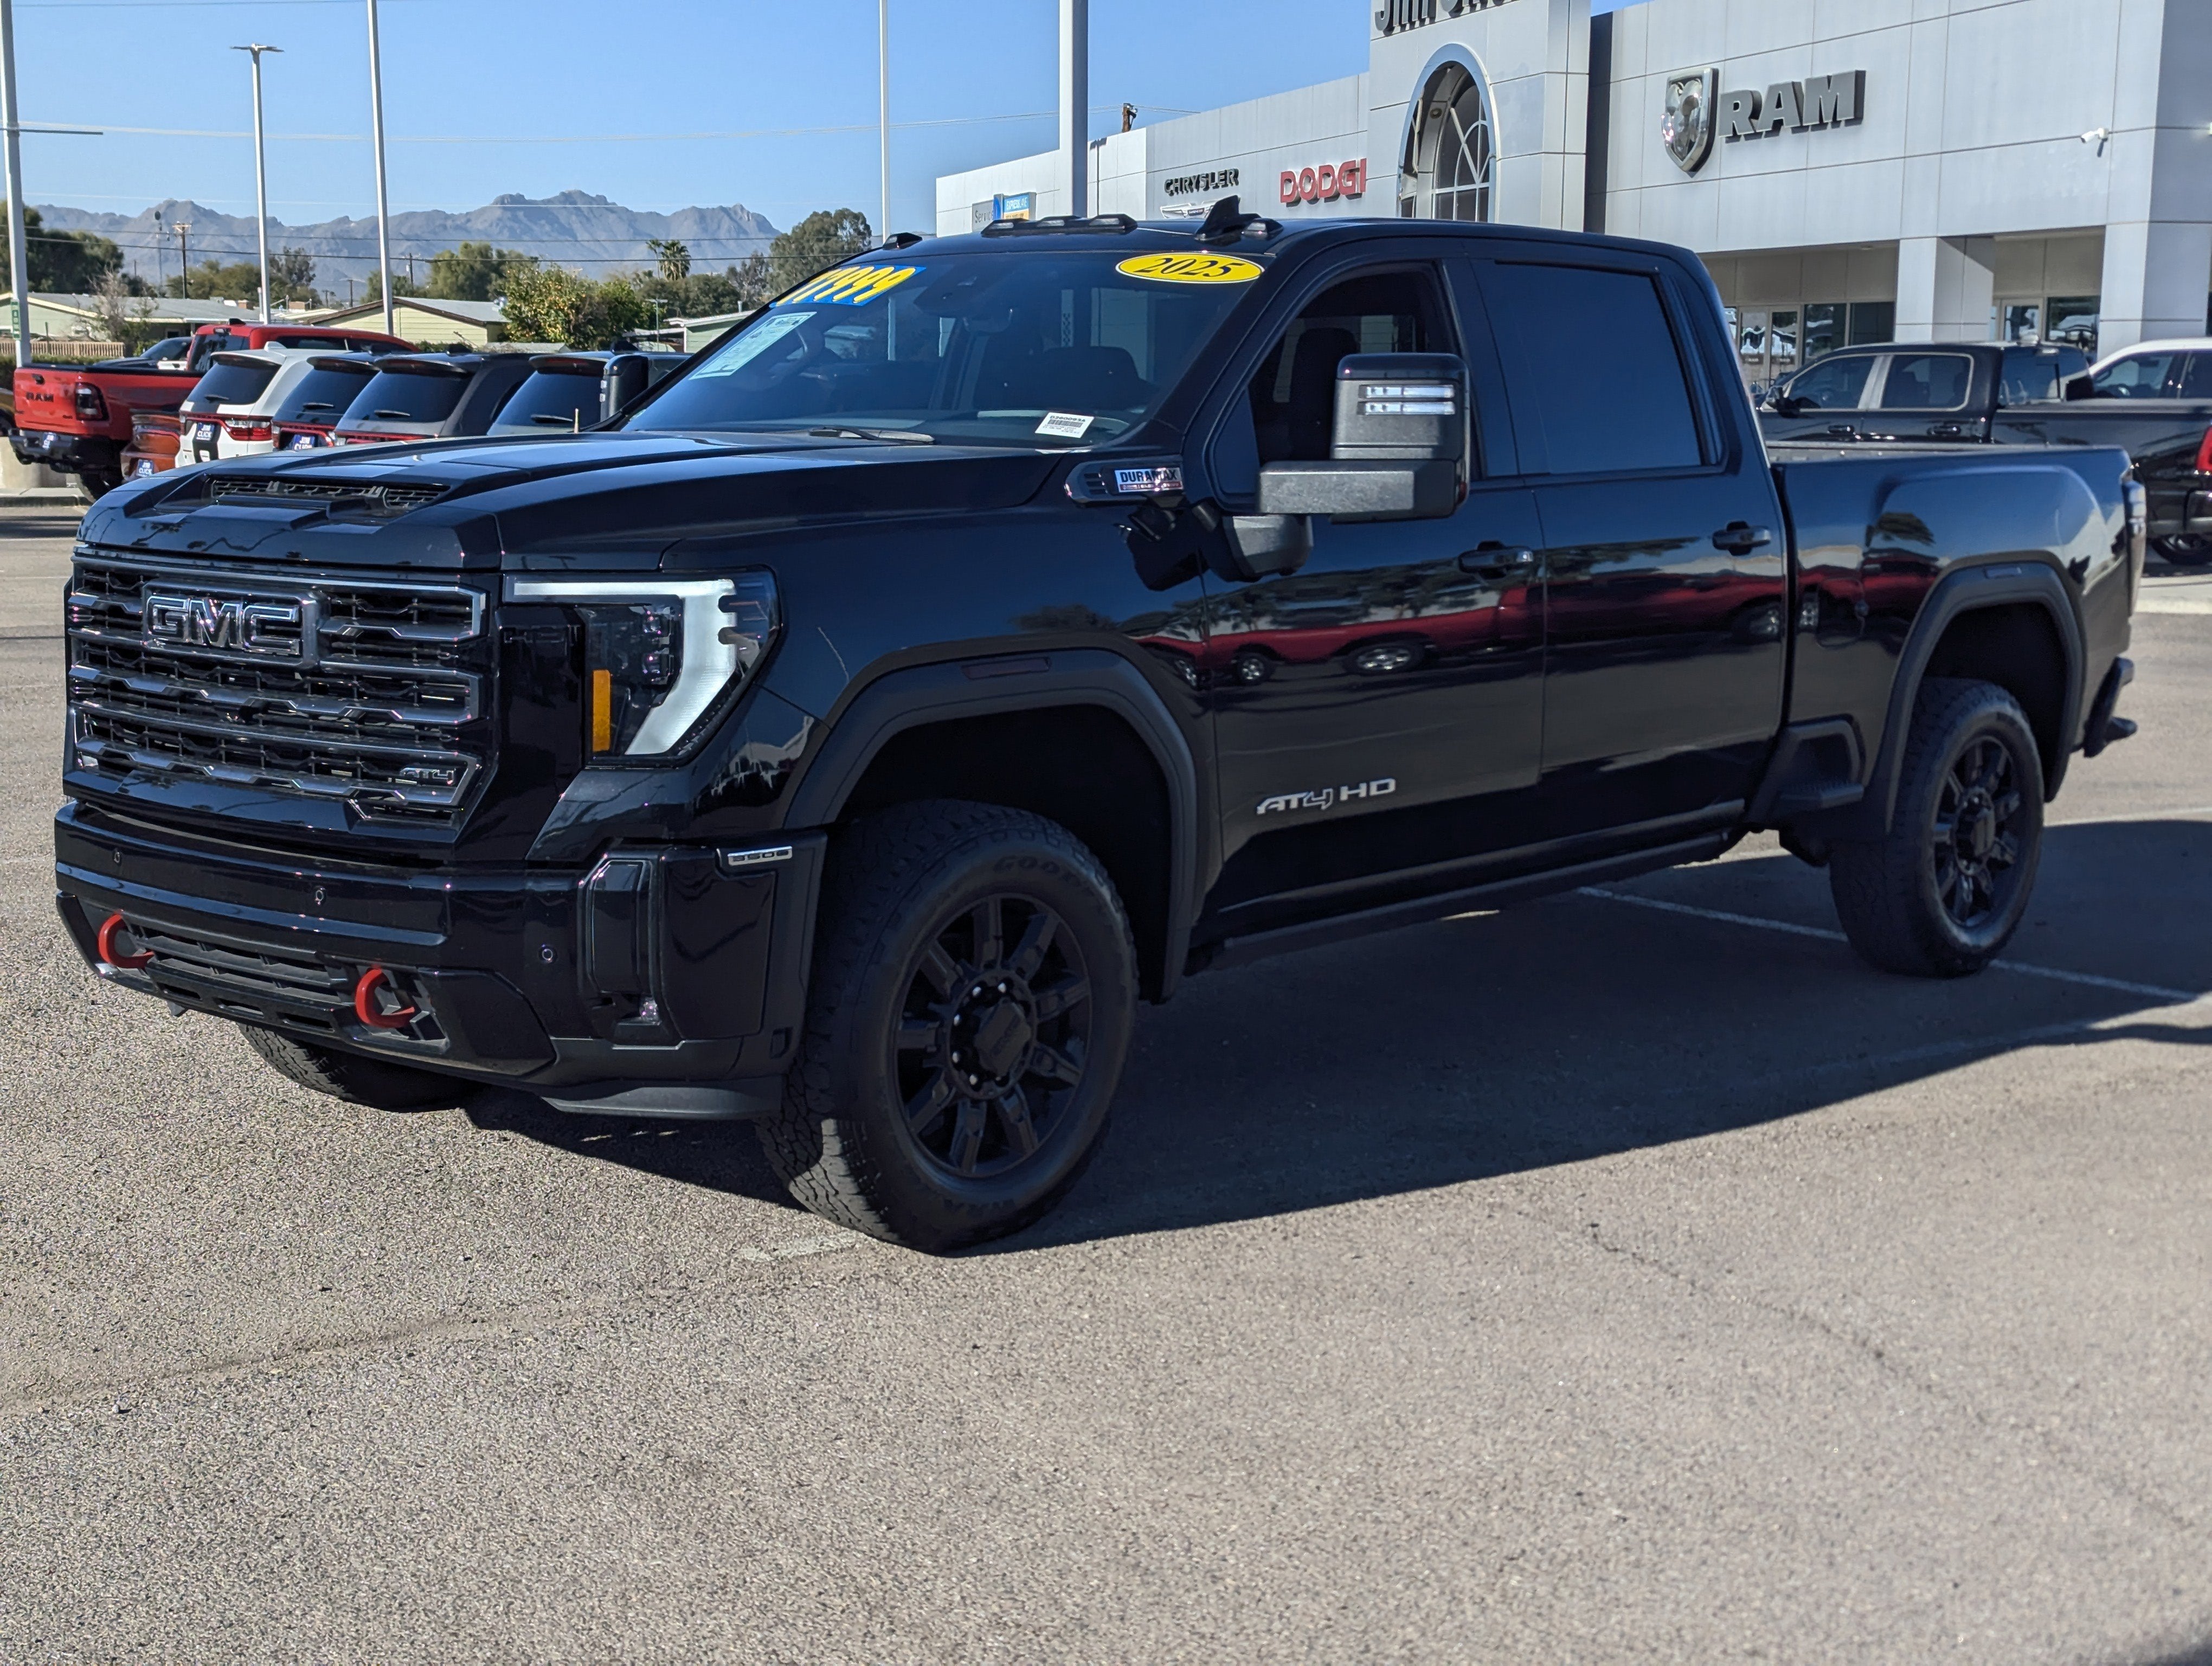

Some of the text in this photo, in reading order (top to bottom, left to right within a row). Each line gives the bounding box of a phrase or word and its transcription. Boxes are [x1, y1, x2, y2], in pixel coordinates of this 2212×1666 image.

[1718, 70, 1863, 139] RAM
[1164, 168, 1239, 196] CHRYSLER
[1134, 257, 1246, 277] 2025
[26, 392, 54, 402] RAM
[146, 595, 300, 656] GMC
[1256, 778, 1396, 814] AT4 HD
